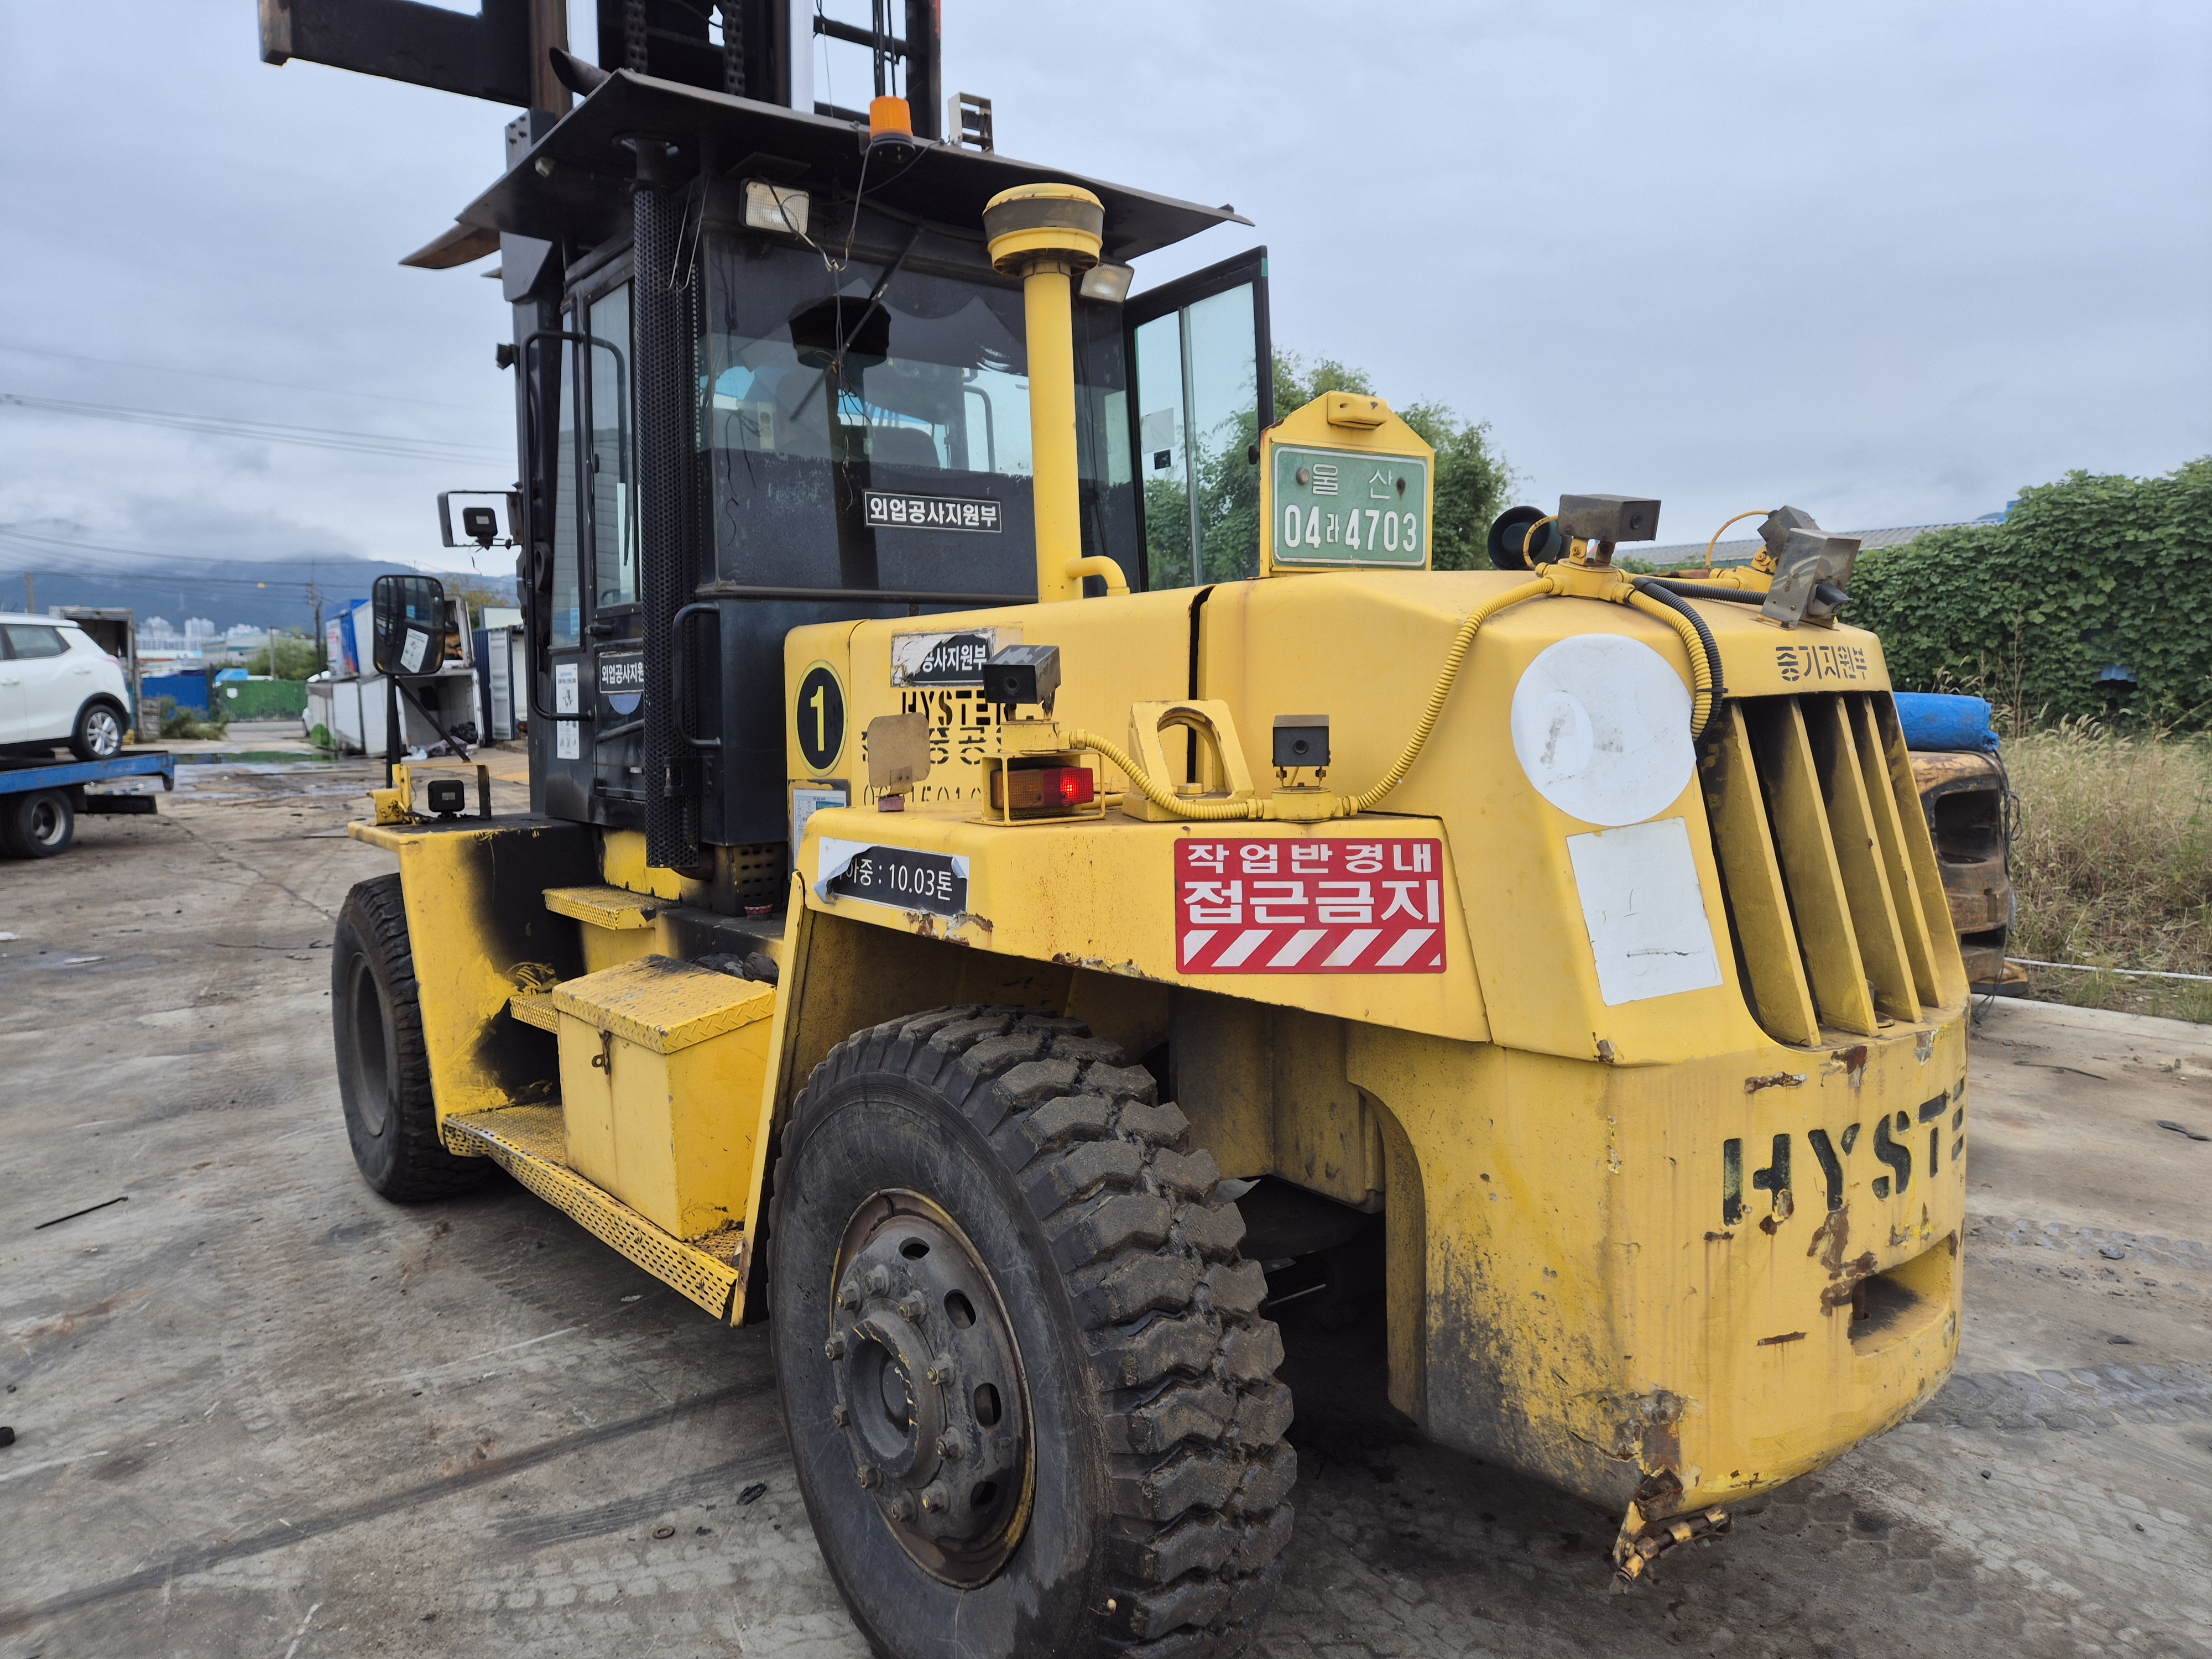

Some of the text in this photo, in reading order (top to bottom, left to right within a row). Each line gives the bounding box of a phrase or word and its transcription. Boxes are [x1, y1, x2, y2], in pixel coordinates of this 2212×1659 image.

[1312, 463, 1392, 499] 울산
[870, 497, 997, 527] 외업공사지원부
[1285, 504, 1417, 551] 04라4703
[602, 661, 644, 684] 외업공사지원
[922, 644, 987, 672] 공사지원부
[1775, 646, 1867, 681] 중기지원부
[810, 686, 825, 752] 1
[902, 690, 1002, 726] HYSTE
[889, 864, 953, 901] 10.03톤
[1184, 880, 1440, 924] 접근금지
[1723, 1074, 1965, 1227] HYSTE
